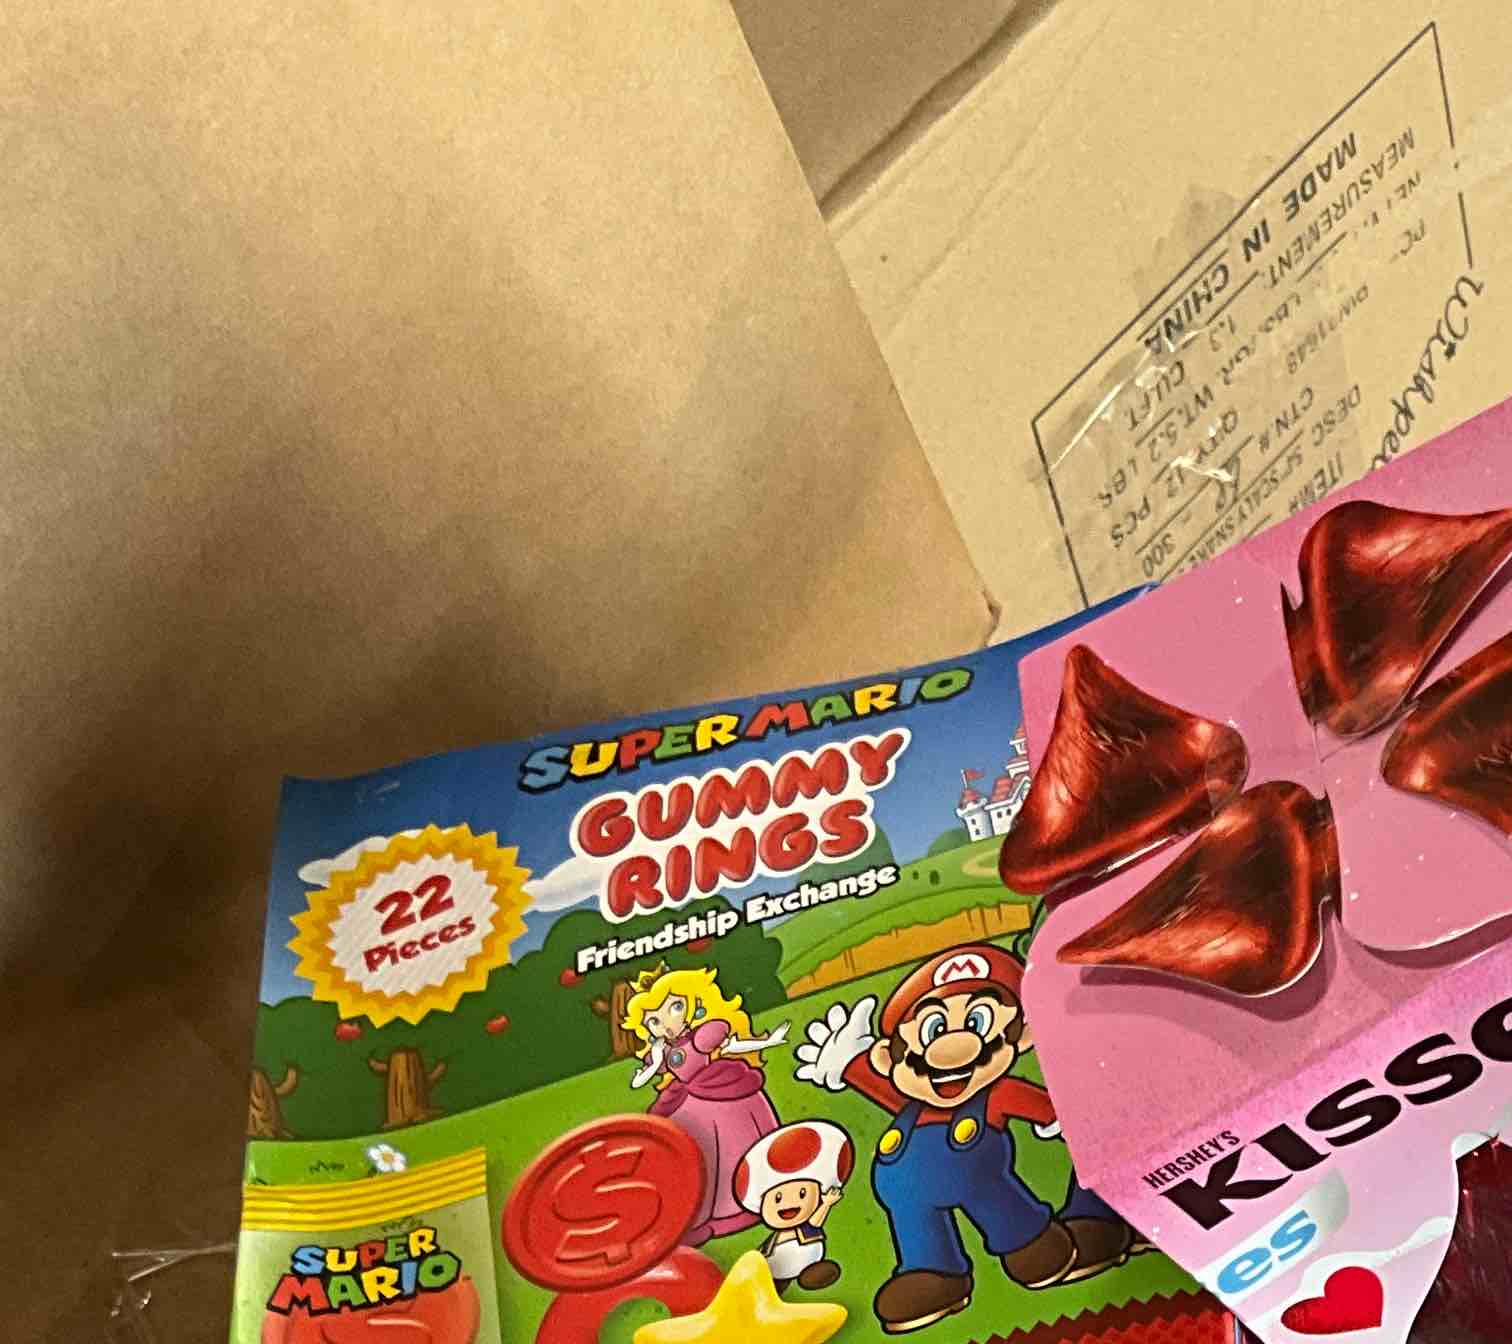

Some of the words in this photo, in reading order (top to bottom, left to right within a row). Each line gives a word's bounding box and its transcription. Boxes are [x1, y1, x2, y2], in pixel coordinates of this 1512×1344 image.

[1282, 132, 1356, 222] MADE
[1241, 218, 1270, 263] IN
[1143, 264, 1230, 355] CHINA
[1110, 495, 1152, 549] PCS
[516, 714, 741, 795] SUPER
[747, 665, 975, 741] MARIO
[574, 730, 906, 858] GUMMY
[602, 798, 874, 923] RINGS
[365, 911, 479, 974] Pieces
[373, 873, 456, 937] 22
[575, 904, 739, 978] Friendship
[746, 861, 901, 931] Exchange
[1141, 1129, 1242, 1190] HERSHEY'S
[266, 1250, 462, 1317] MARIO
[290, 1228, 440, 1277] SUPER
[1216, 1207, 1318, 1295] es
